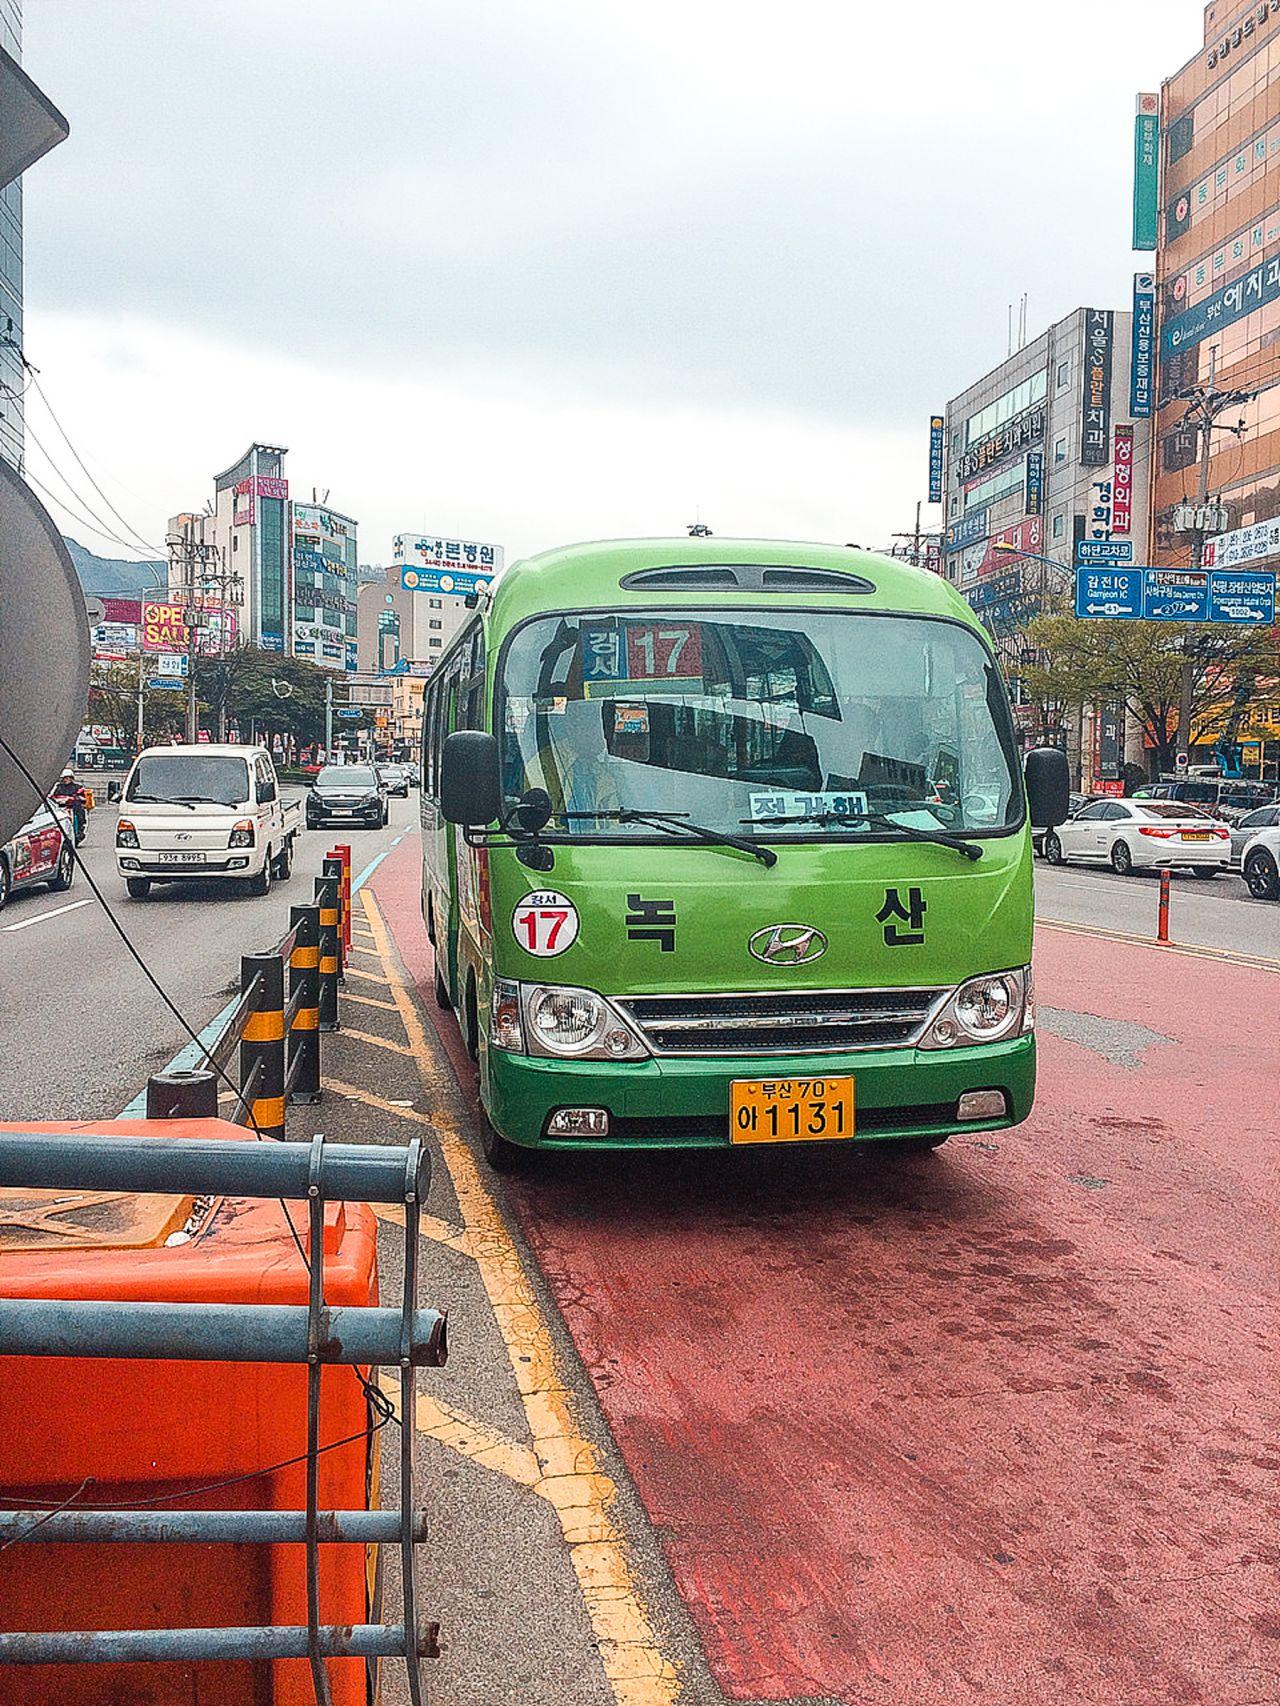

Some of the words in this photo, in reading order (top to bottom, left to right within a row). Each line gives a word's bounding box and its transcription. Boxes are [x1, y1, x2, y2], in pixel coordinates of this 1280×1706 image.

[1136, 300, 1151, 403] 부산신용보증재단
[1114, 440, 1132, 530] 성형외과
[446, 542, 494, 564] 본병원
[1080, 545, 1130, 557] 하단교차로
[589, 632, 619, 677] 강서
[634, 630, 690, 674] 17
[531, 894, 556, 906] 강서
[625, 894, 676, 952] 녹
[874, 887, 927, 946] 산
[519, 911, 568, 950] 17
[762, 1083, 792, 1099] 부산
[798, 1081, 825, 1098] 70
